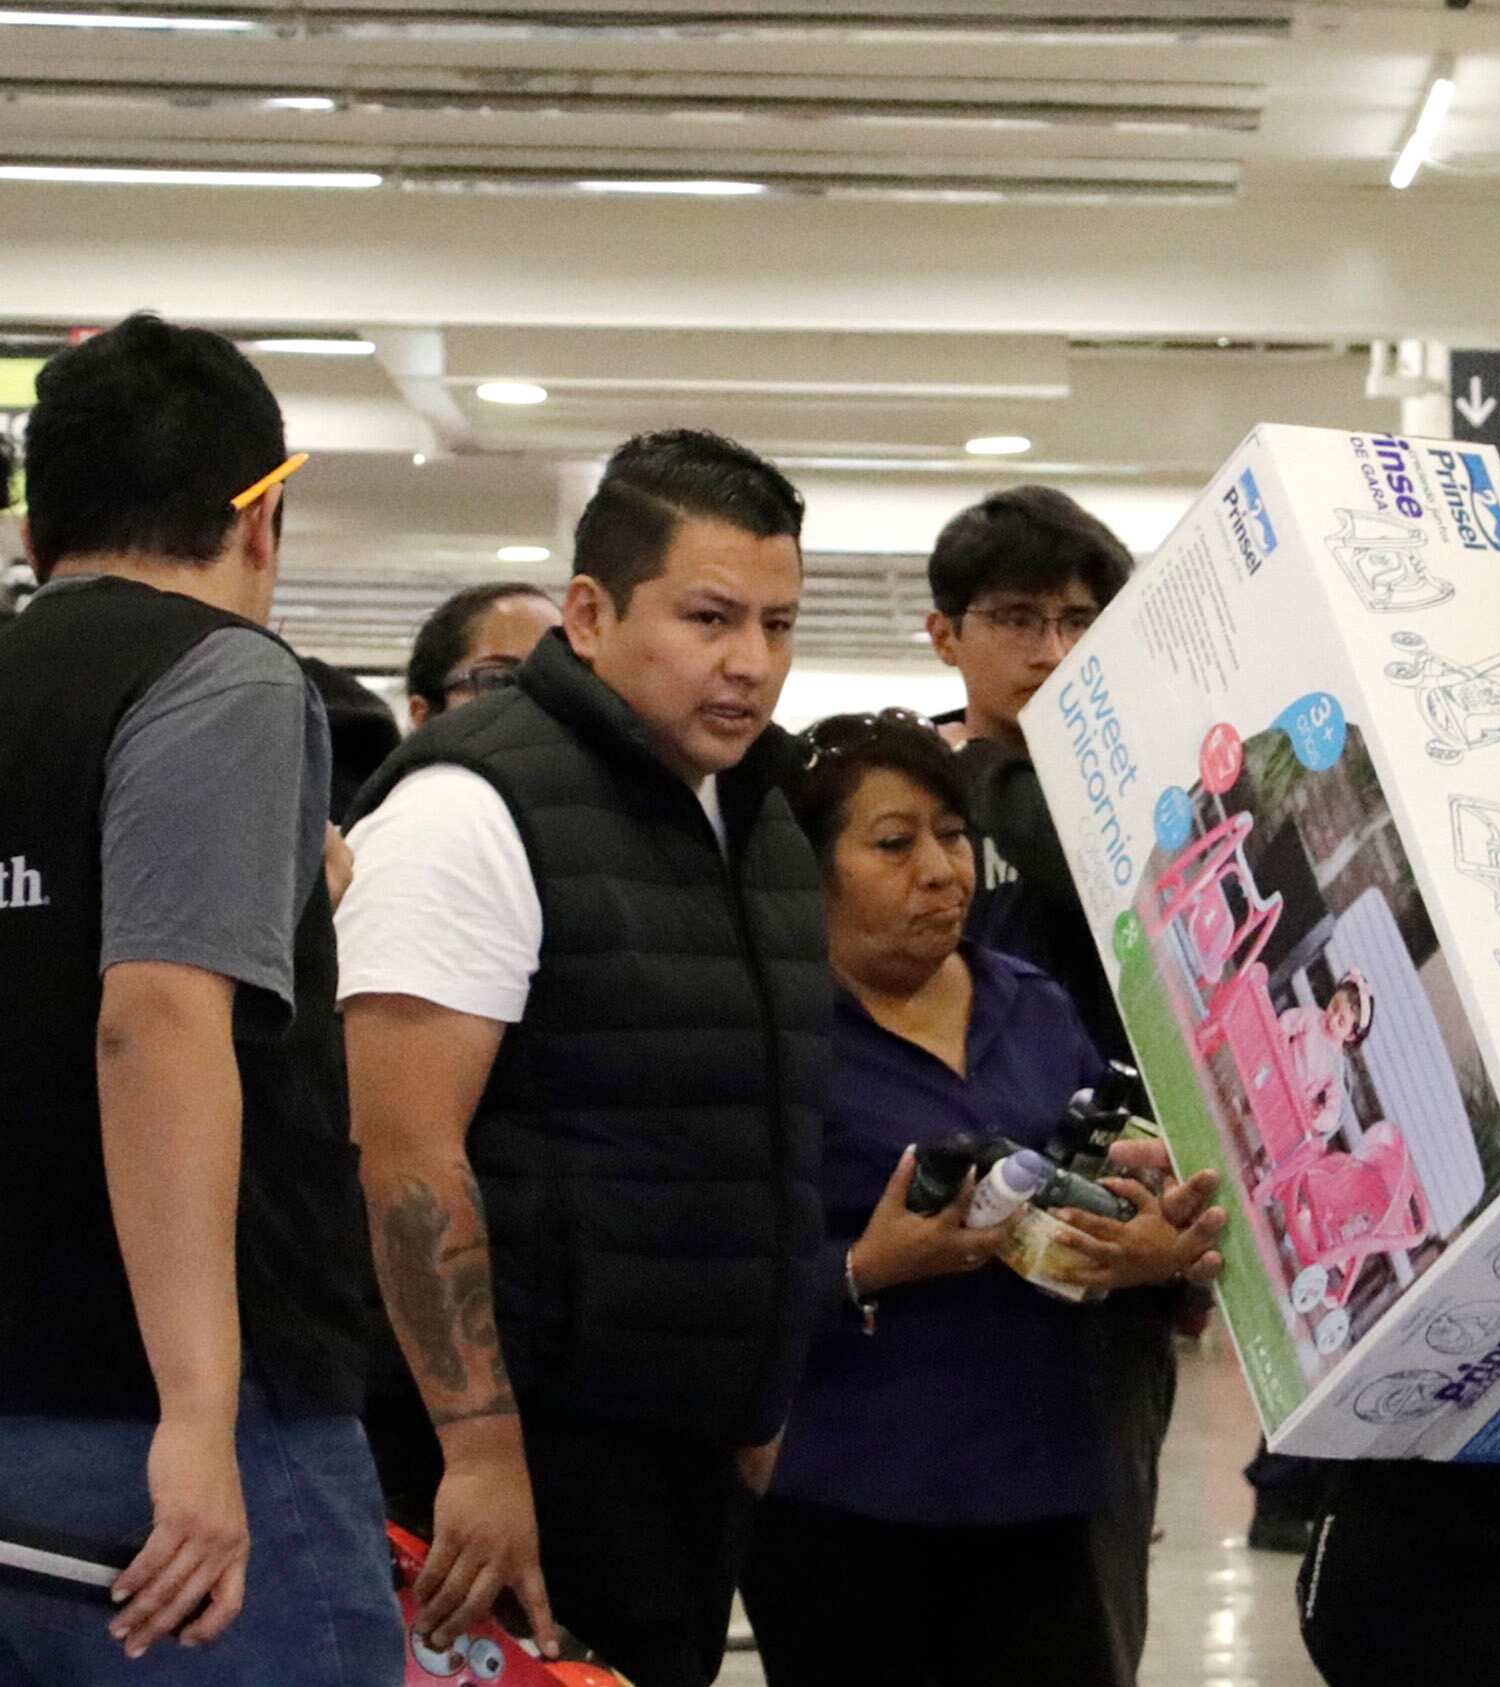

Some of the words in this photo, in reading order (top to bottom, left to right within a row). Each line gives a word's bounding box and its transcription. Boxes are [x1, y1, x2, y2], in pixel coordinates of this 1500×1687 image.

[1222, 485, 1263, 577] Prinsel
[1427, 448, 1488, 551] Prinsel
[1058, 682, 1134, 886] unicornio
[1081, 655, 1137, 797] sweet
